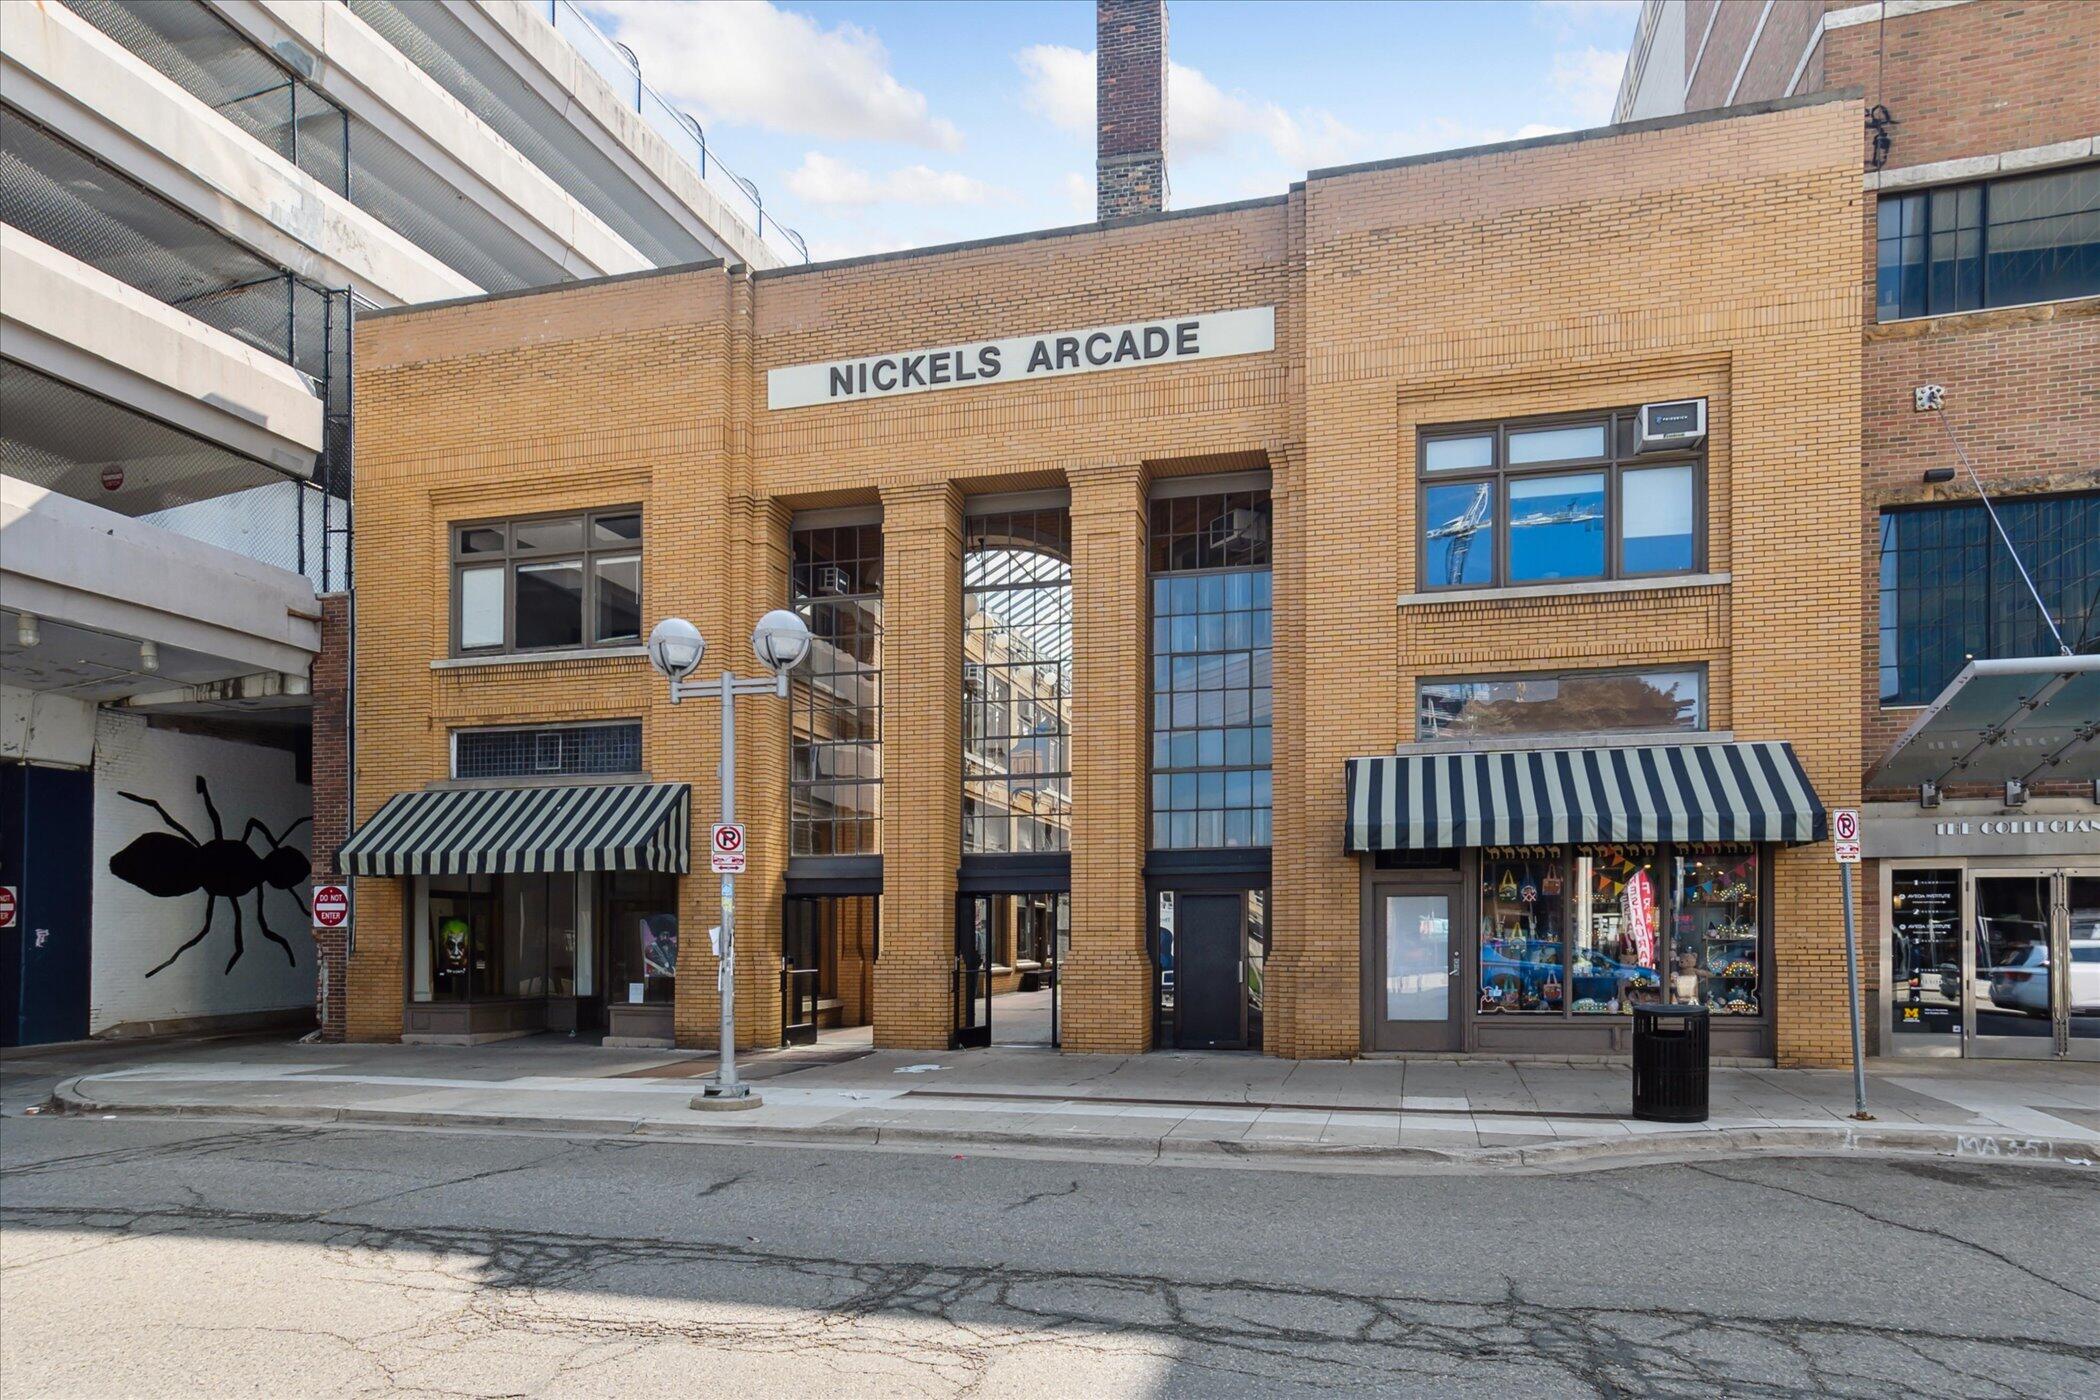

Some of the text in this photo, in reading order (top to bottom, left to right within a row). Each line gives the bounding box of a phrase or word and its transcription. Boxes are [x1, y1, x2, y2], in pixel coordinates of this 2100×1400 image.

[829, 321, 1200, 396] NICKELS ARCADE
[1933, 822, 1973, 835] THE
[321, 911, 341, 919] ENTER
[1904, 1007, 1920, 1018] M
